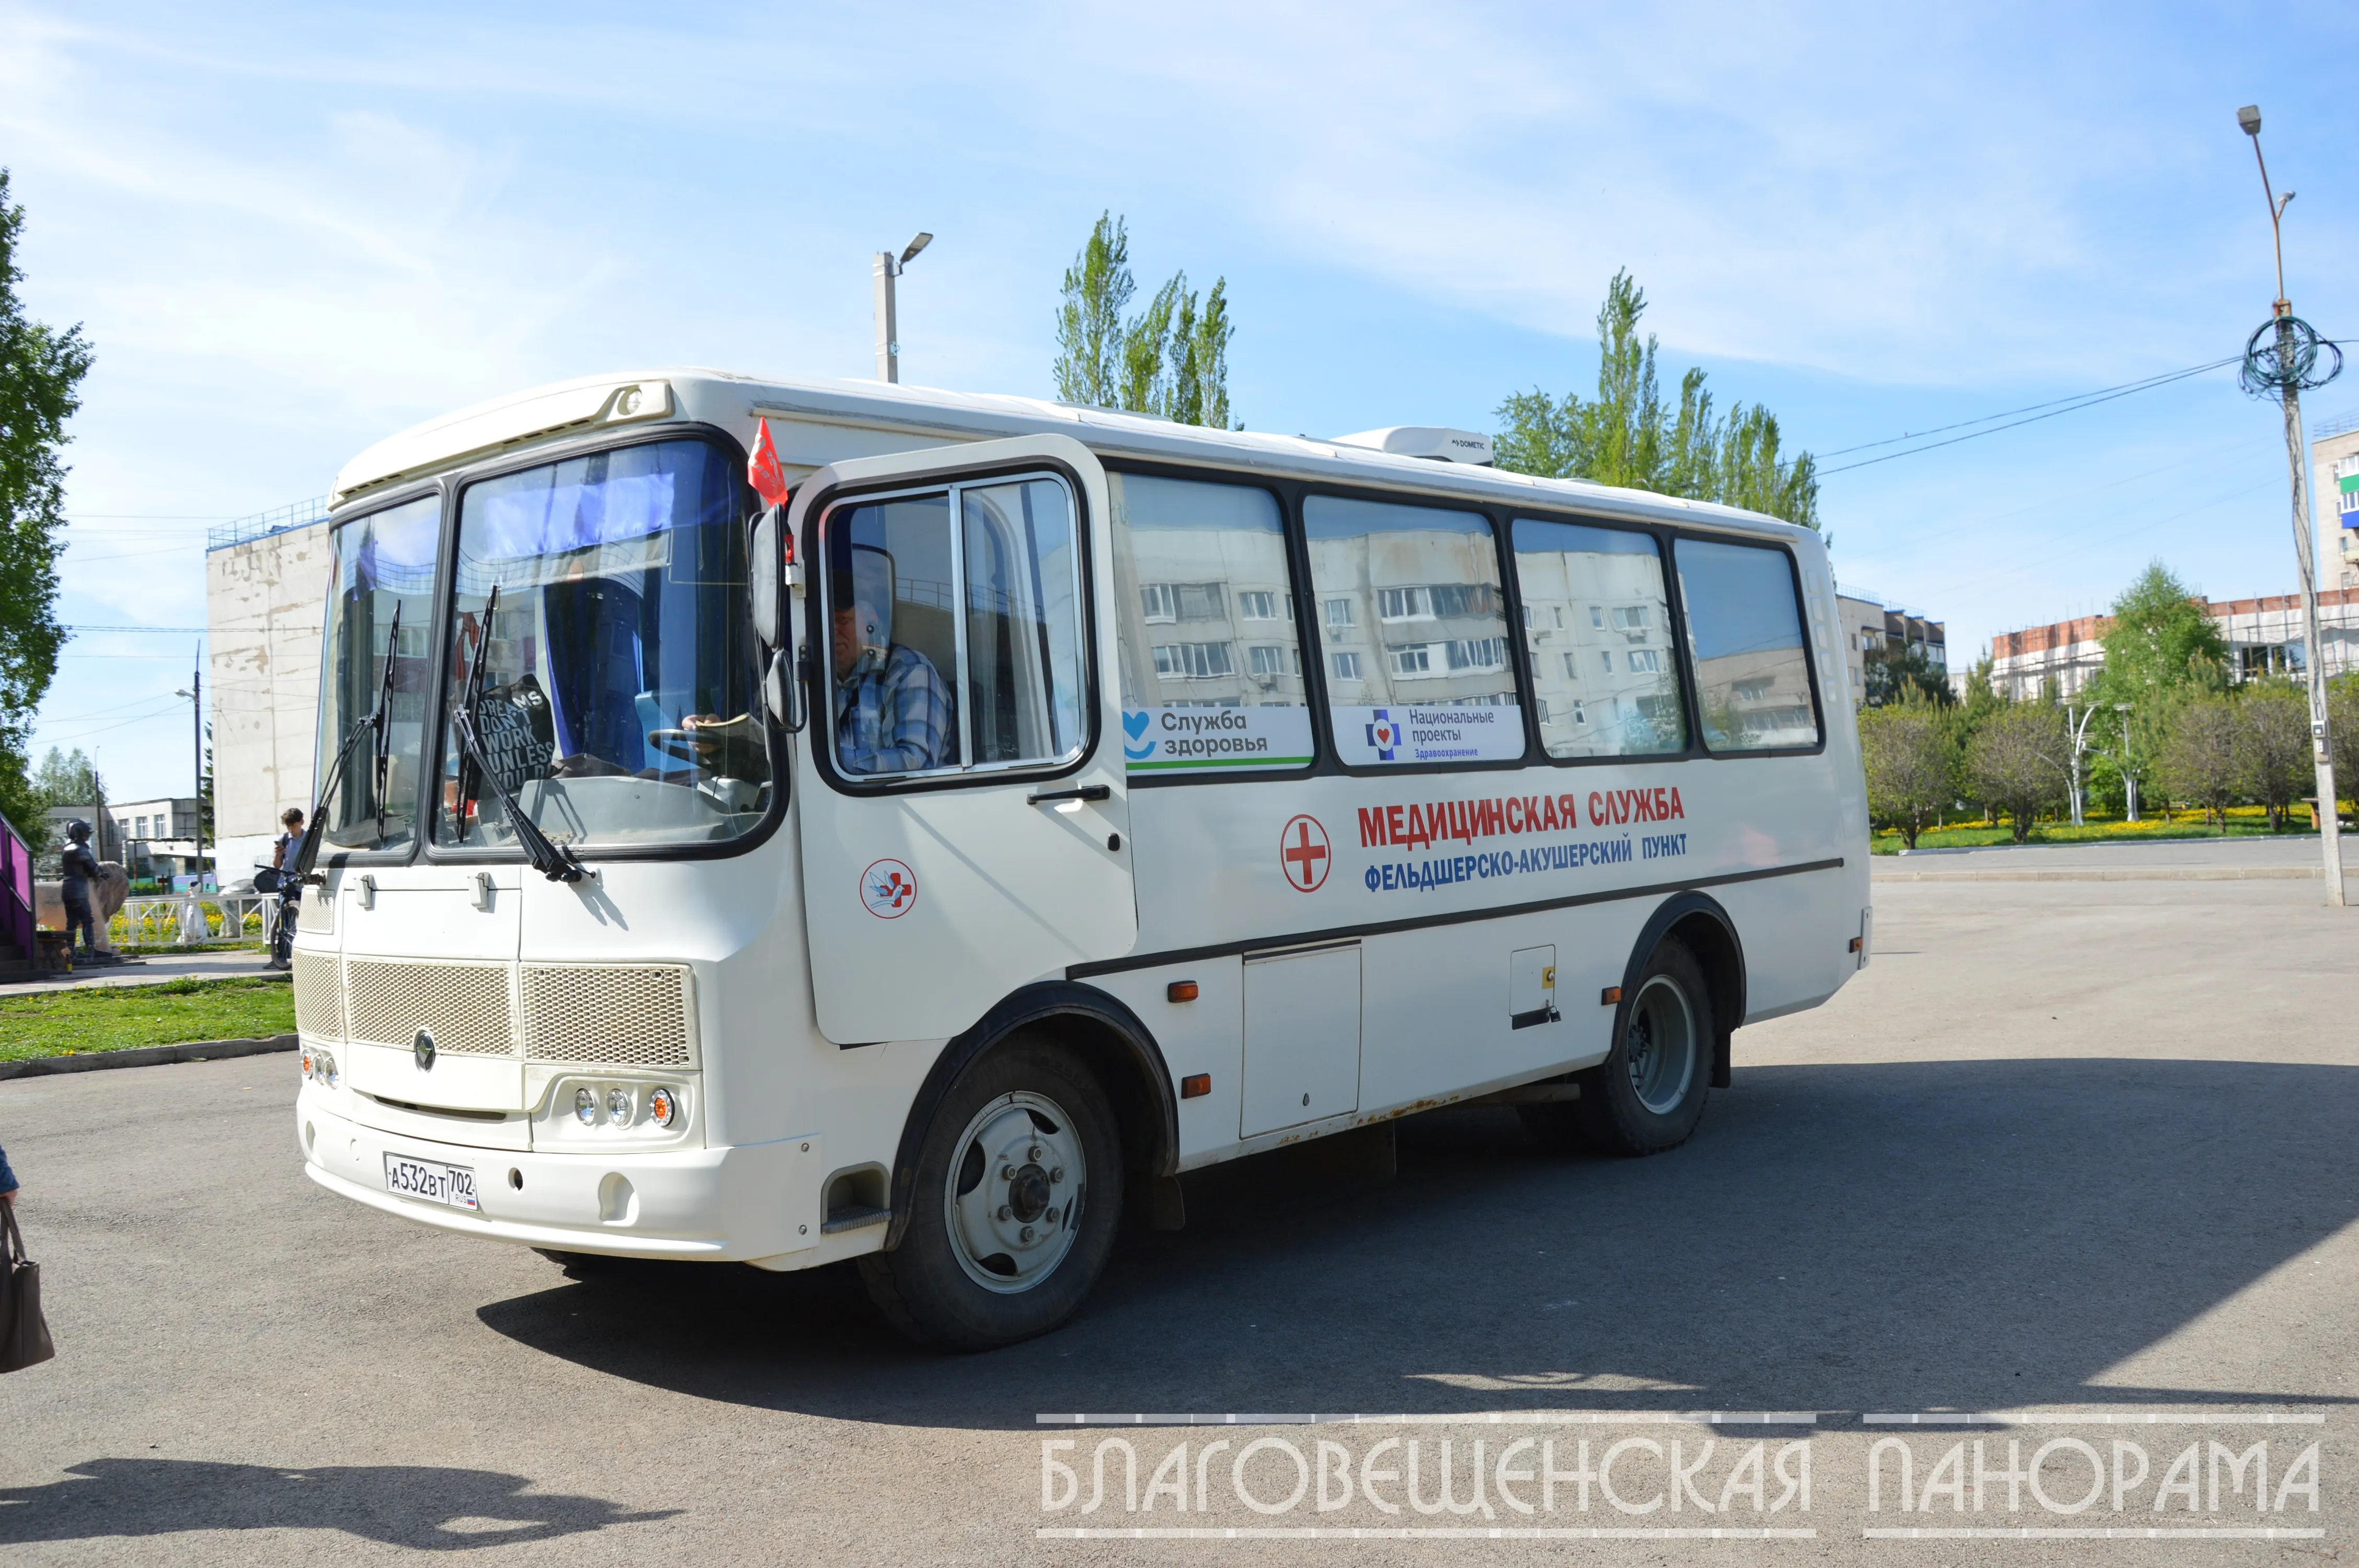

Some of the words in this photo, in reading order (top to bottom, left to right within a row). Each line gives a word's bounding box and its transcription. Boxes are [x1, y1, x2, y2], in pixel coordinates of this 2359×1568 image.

[1460, 440, 1485, 449] DOMETIC
[479, 708, 531, 734] DON'T
[1161, 710, 1247, 735] Служба
[1409, 709, 1494, 727] Национальные
[481, 725, 537, 754] WORK
[1164, 737, 1268, 758] здоровья
[1412, 730, 1461, 746] проекты
[487, 741, 554, 774] UNLESS
[1415, 748, 1479, 760] Здравоохранение
[1358, 794, 1577, 851] МЕДИЦИНСКАЯ
[1588, 787, 1685, 826] СЛУЖБА
[1365, 833, 1632, 892] ФЕЛЬДШЕРСКО-АКУШЕРСКИЙ
[1642, 834, 1687, 859] ПУНКТ
[449, 1170, 473, 1195] 702
[455, 1194, 466, 1204] RUS
